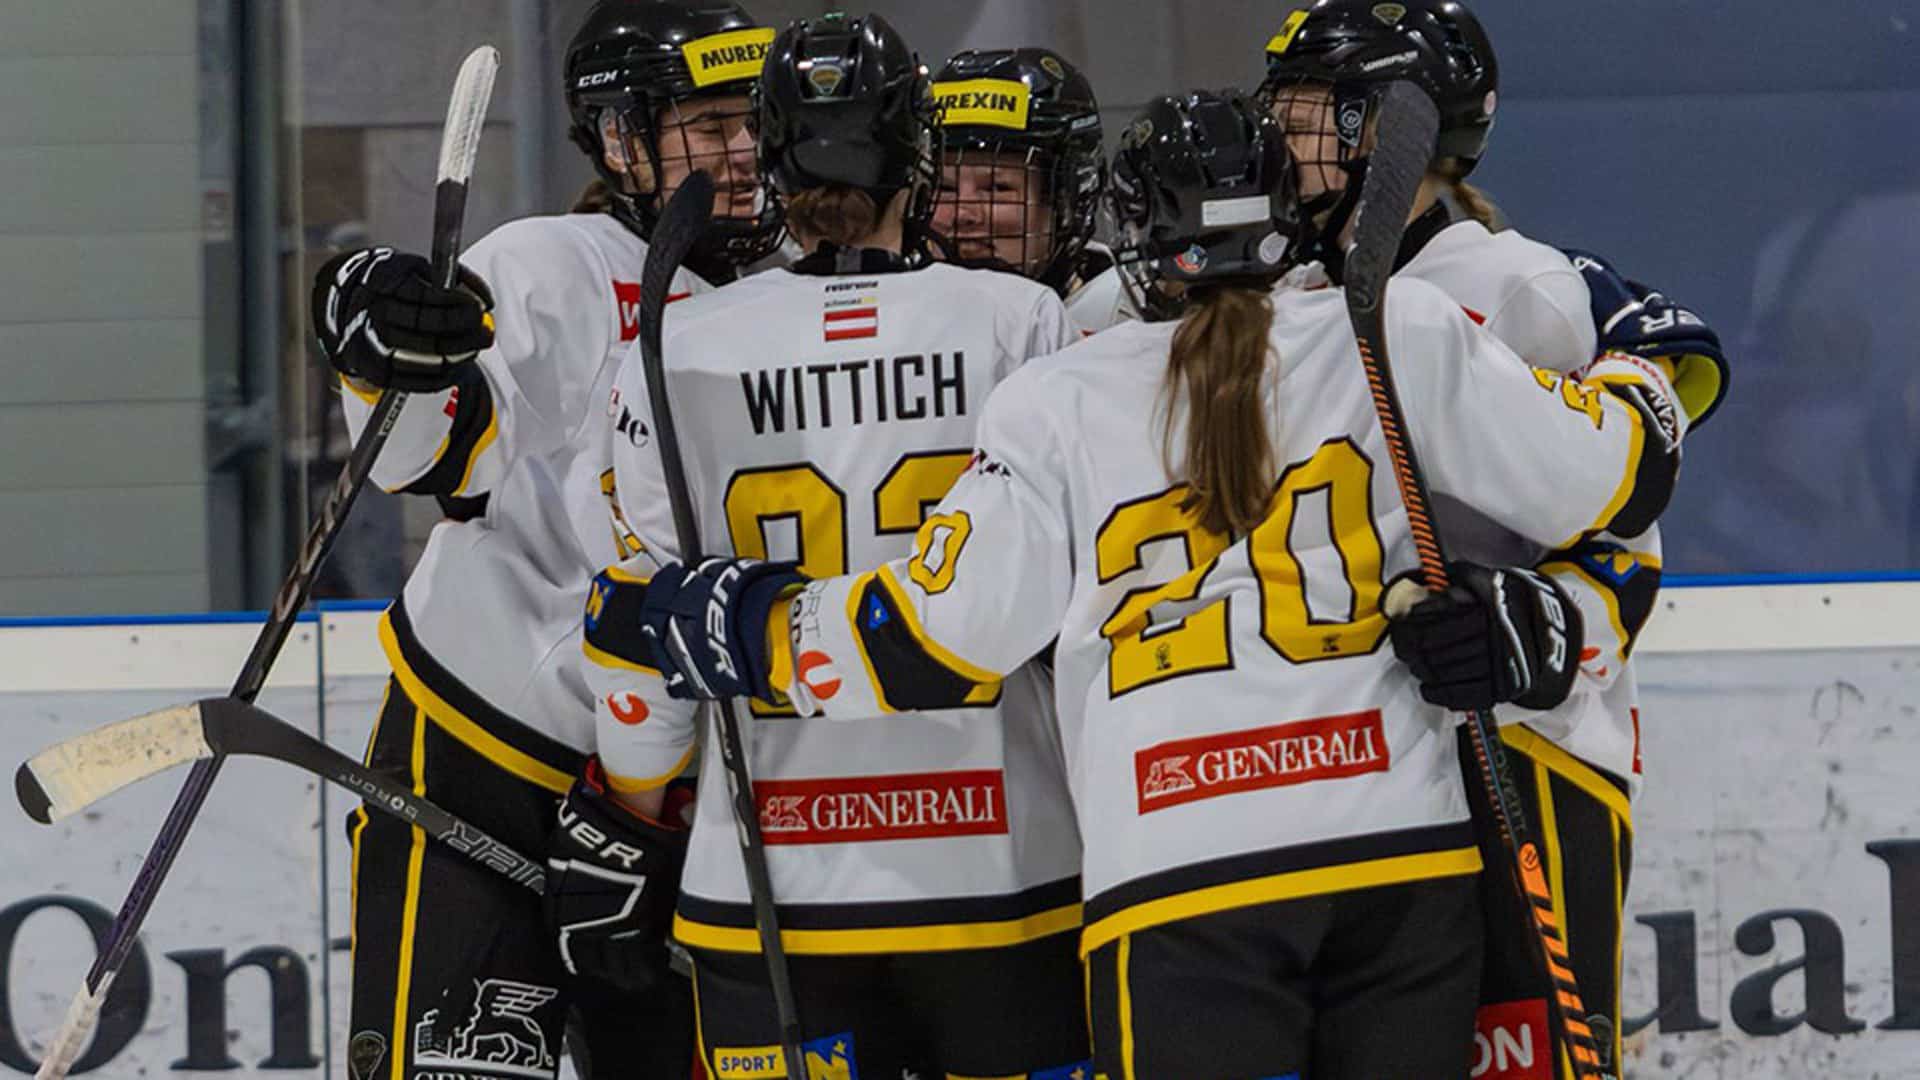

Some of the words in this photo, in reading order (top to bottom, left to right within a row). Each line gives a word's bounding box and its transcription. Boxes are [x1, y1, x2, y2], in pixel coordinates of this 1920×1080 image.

[701, 42, 768, 70] MUREX
[578, 69, 619, 88] CCM
[936, 91, 1018, 112] REXIN
[740, 351, 967, 436] WITTICH
[1096, 436, 1390, 698] 20
[1197, 726, 1381, 785] GENERALI
[811, 785, 996, 831] GENERALI
[721, 1054, 776, 1072] SPORT
